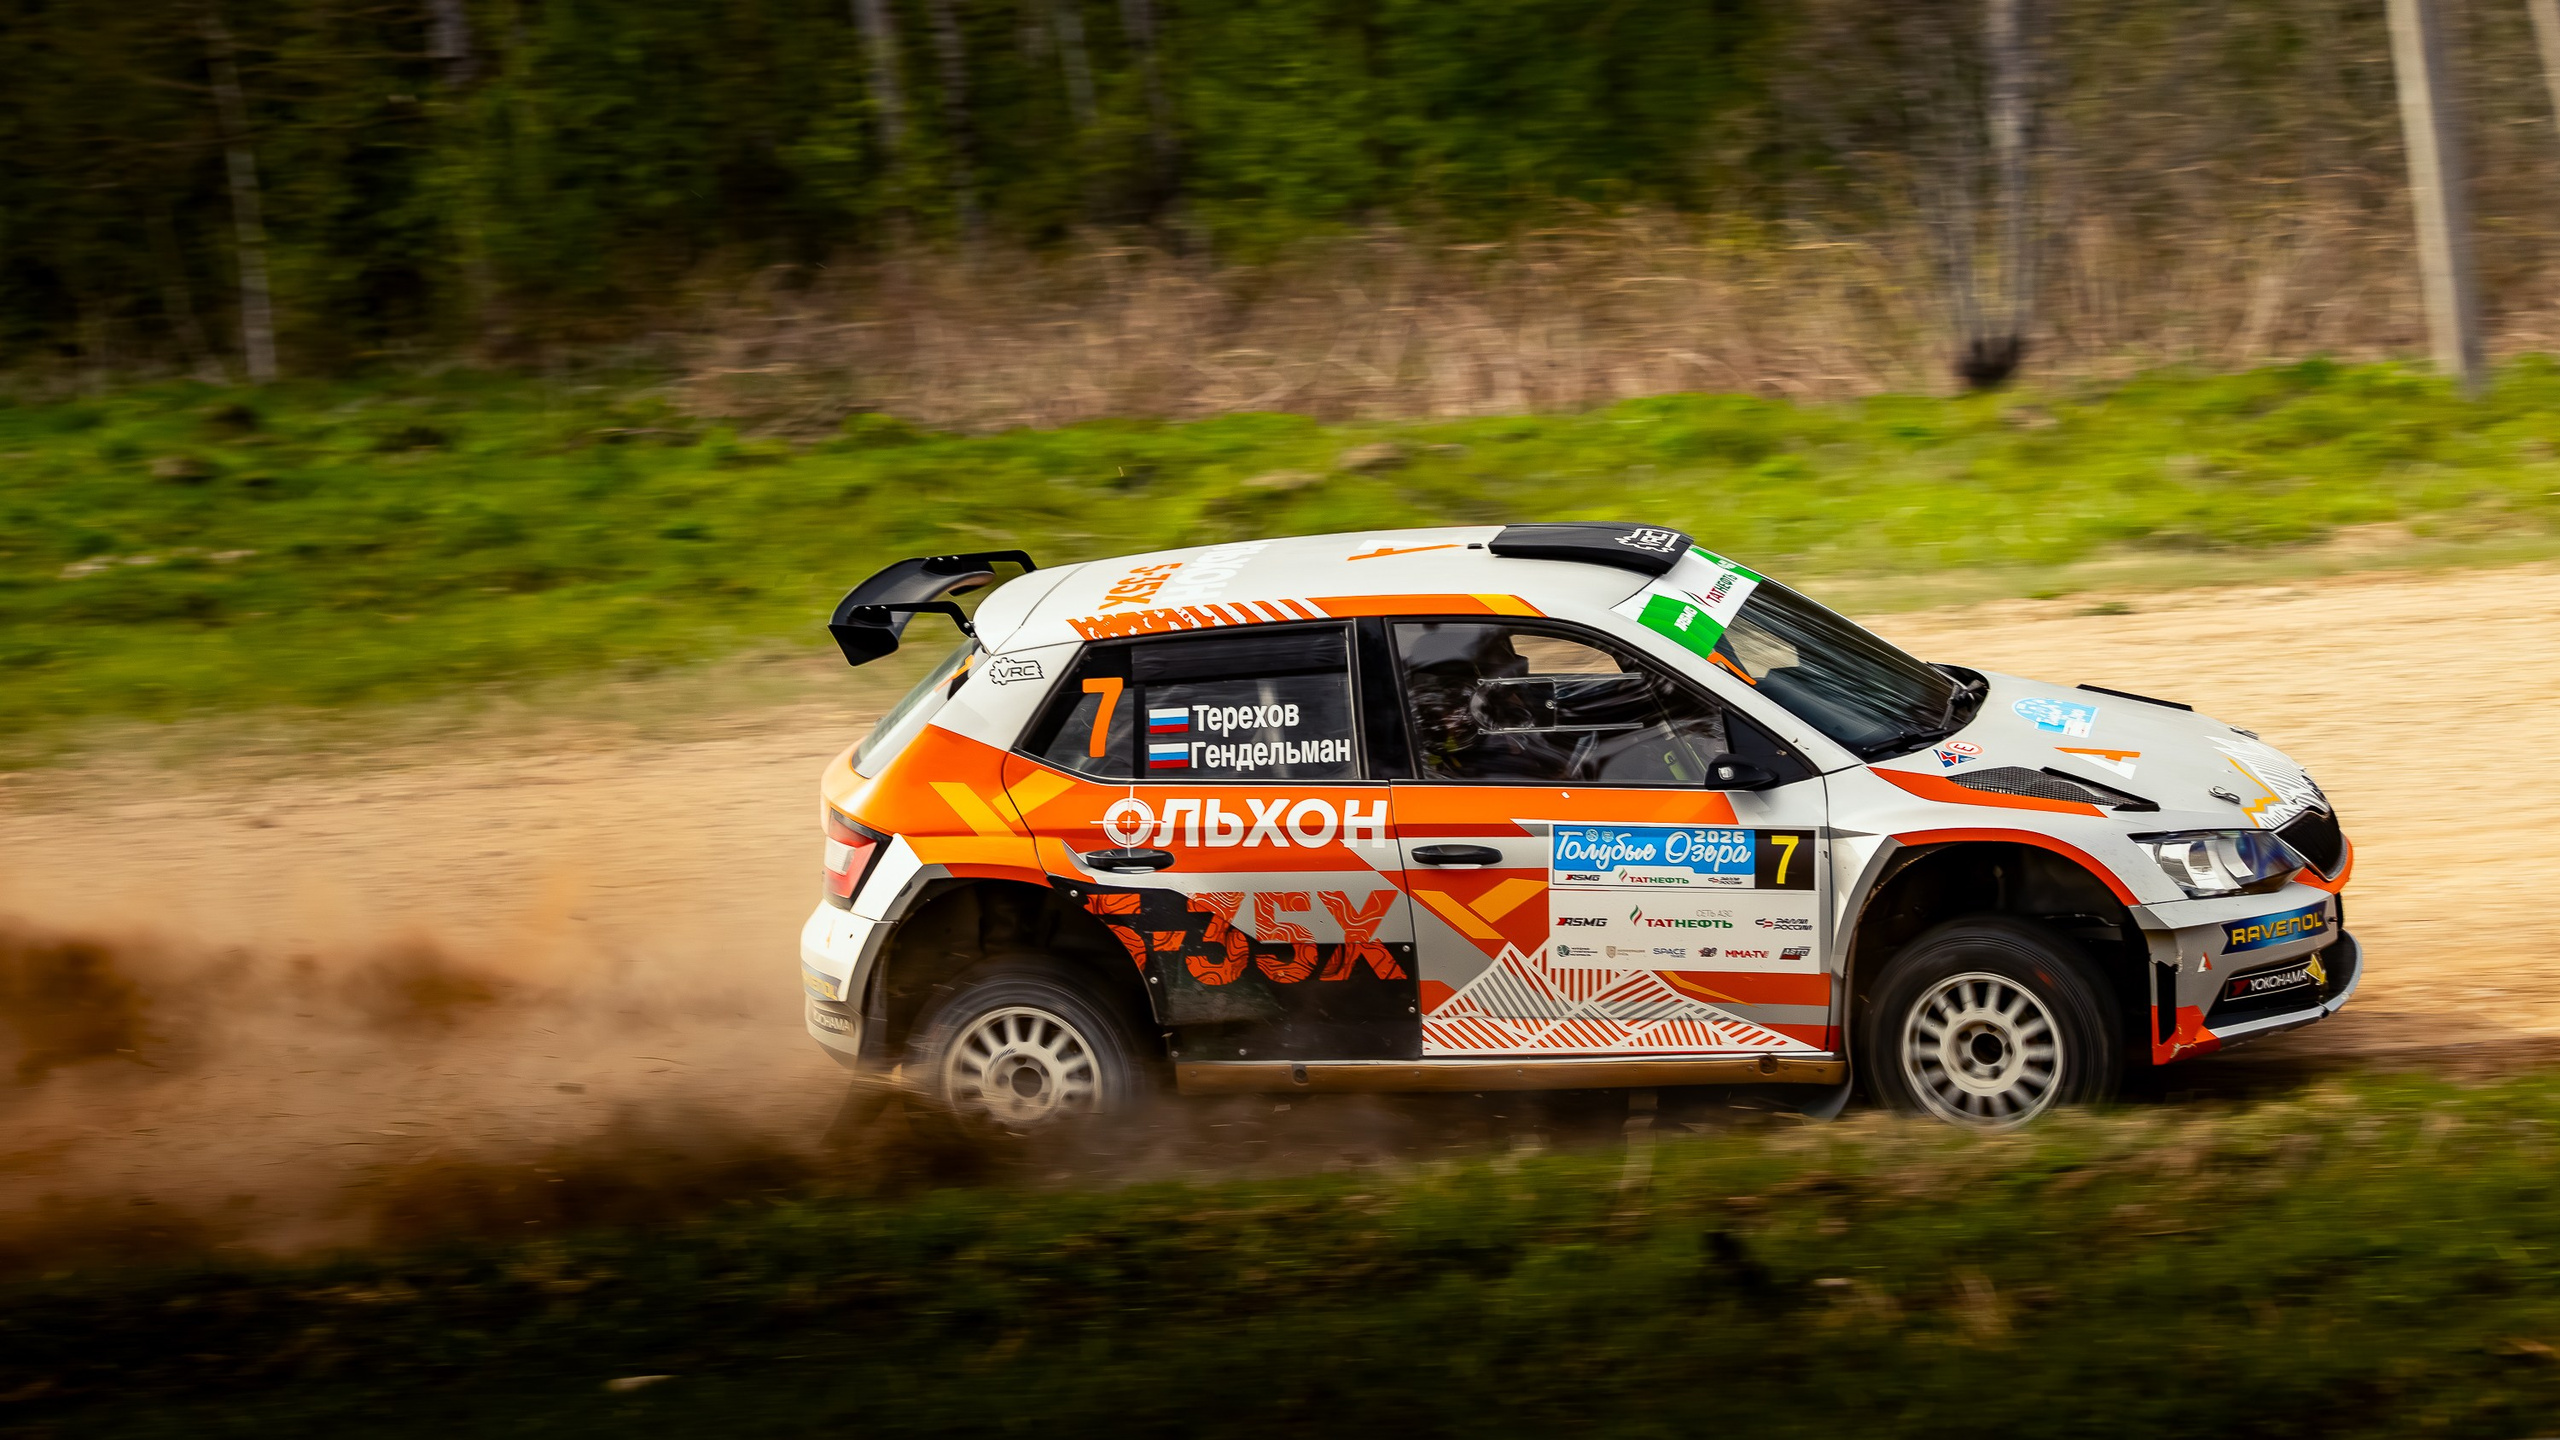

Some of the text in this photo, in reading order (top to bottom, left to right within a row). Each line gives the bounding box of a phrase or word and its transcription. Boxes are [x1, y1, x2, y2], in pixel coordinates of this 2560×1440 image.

[1082, 677, 1124, 758] 7
[1192, 704, 1300, 737] Терехов
[1191, 738, 1351, 771] Гендельман
[1102, 797, 1388, 849] ОЛЬХОН
[1693, 830, 1746, 844] 2026
[1665, 831, 1752, 873] Озера
[1771, 835, 1799, 884] 7
[1565, 874, 1600, 882] RSMG
[1629, 876, 1689, 884] ТАТНЕФТЬ
[1556, 917, 1608, 927] RSMG
[1645, 918, 1733, 929] ТАТНЕФТЬ
[1696, 910, 1733, 918] СЕТЬ АЗС
[2231, 912, 2323, 945] RAVENOL
[1652, 947, 1686, 955] SPACE
[2250, 969, 2308, 991] YOKOHAMA
